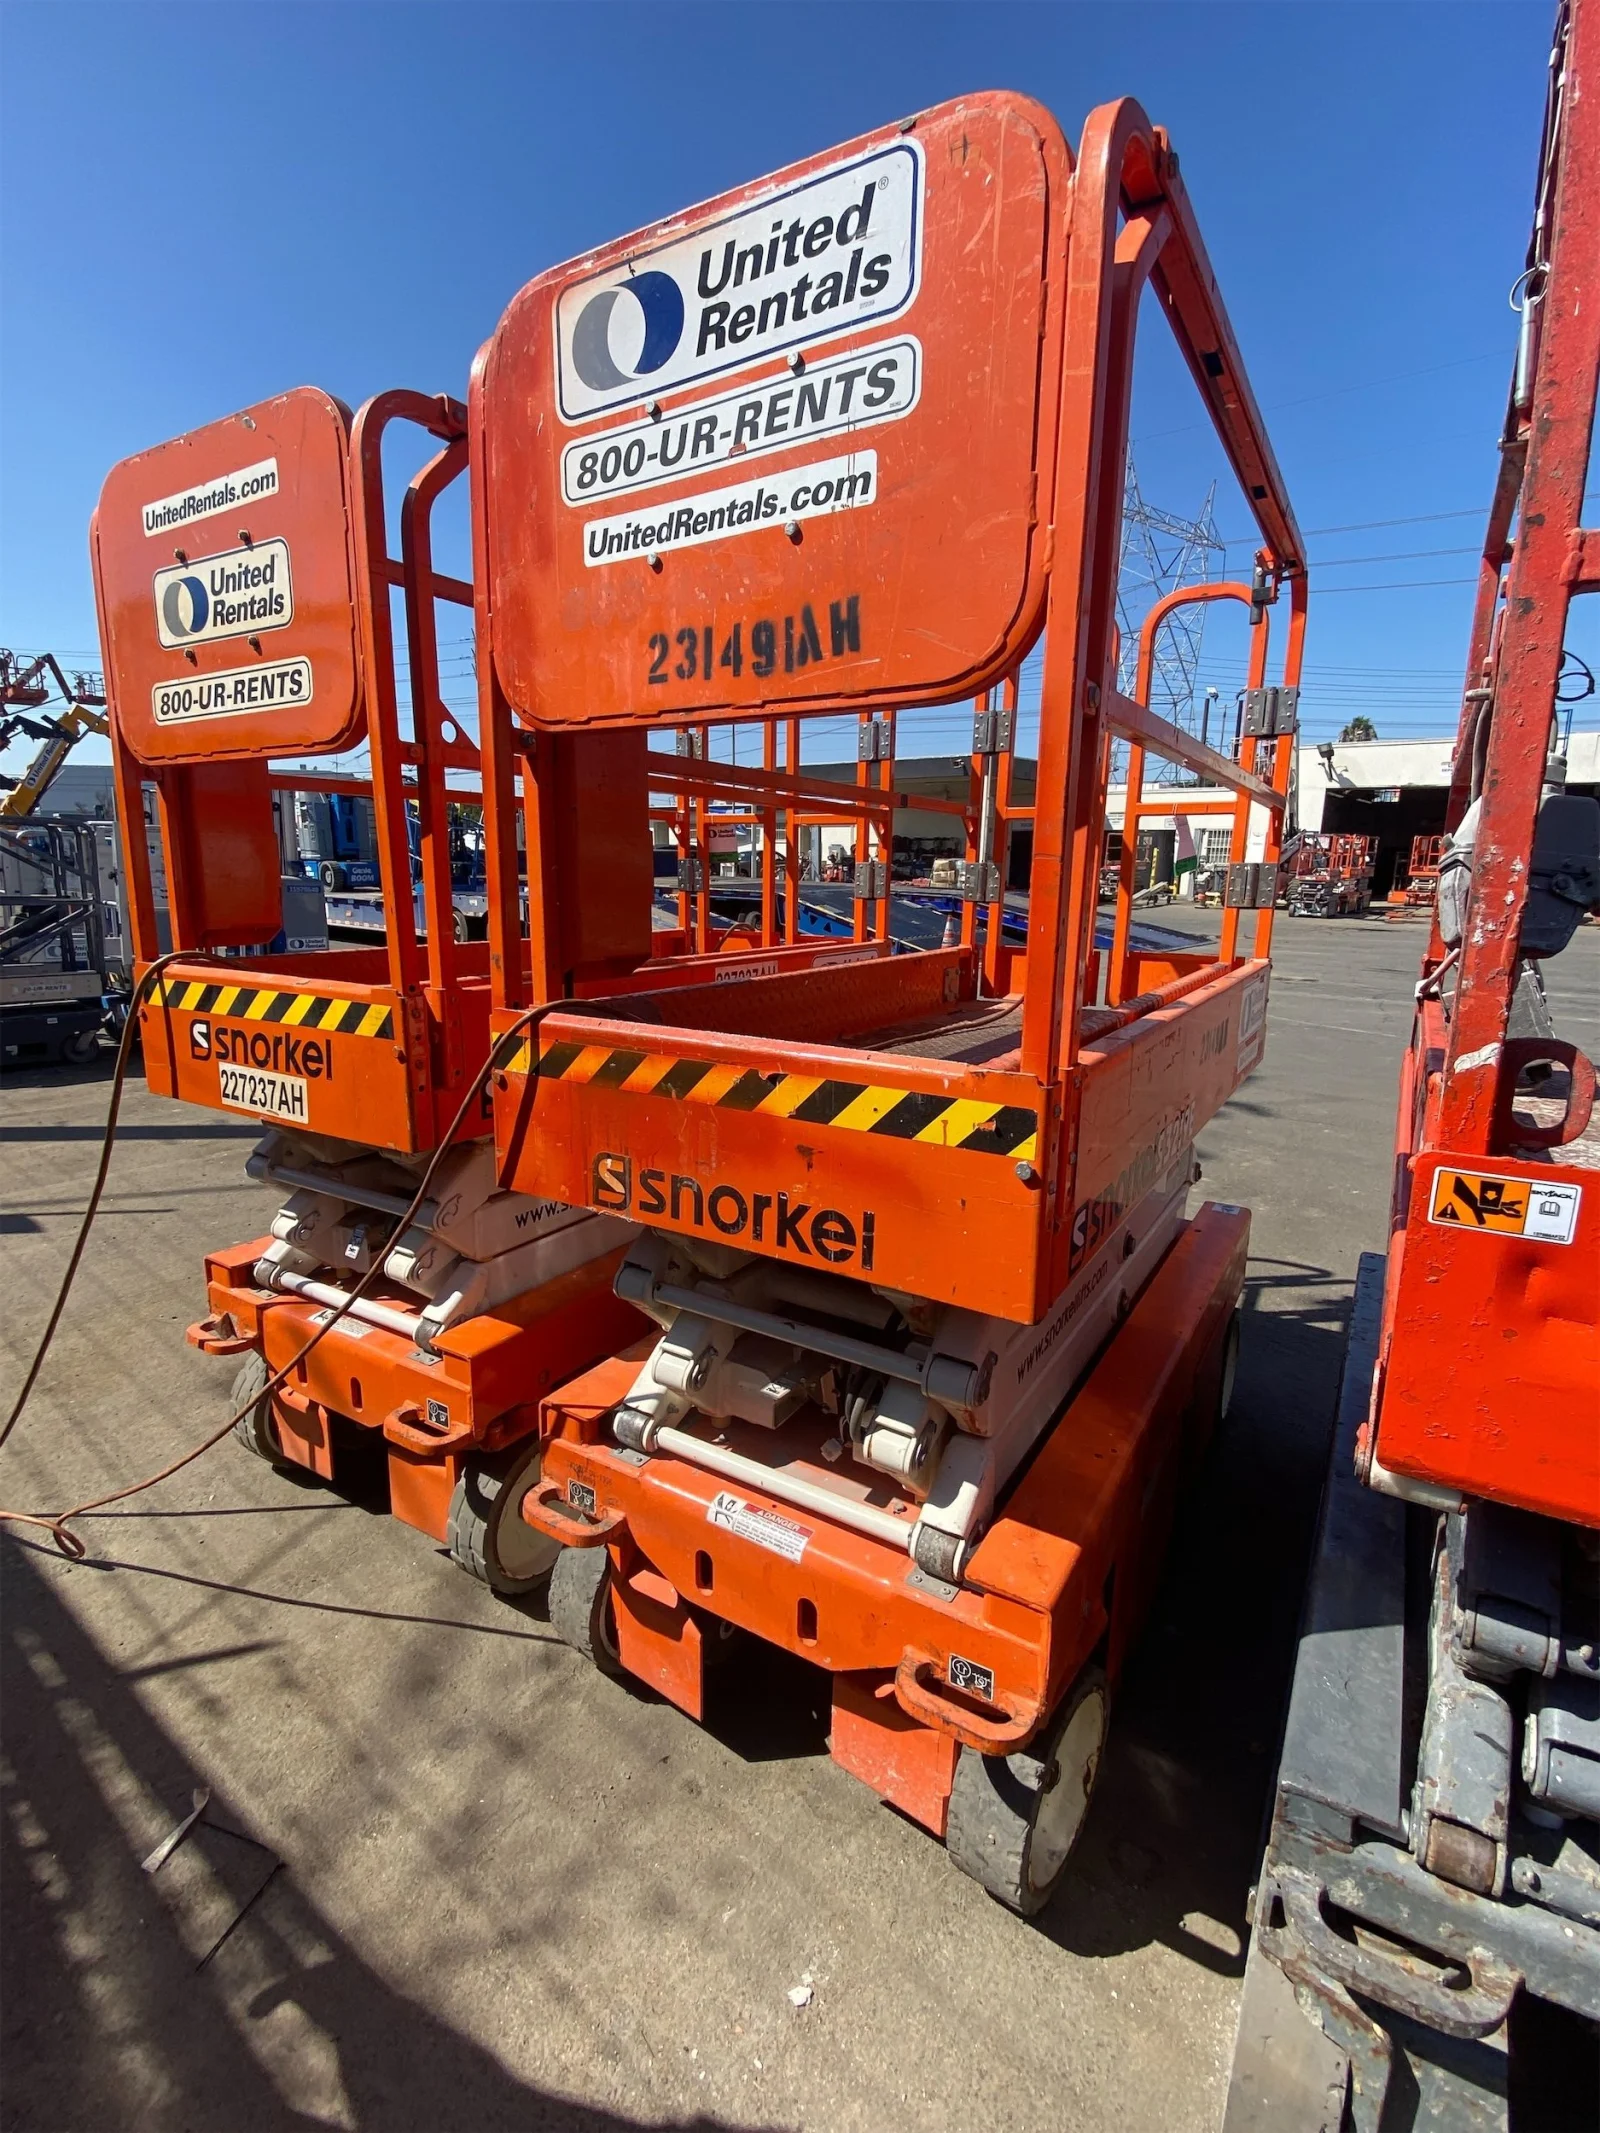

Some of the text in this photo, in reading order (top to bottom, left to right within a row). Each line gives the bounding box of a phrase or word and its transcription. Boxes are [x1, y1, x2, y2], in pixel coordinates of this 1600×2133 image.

[697, 181, 876, 299] United
[695, 249, 892, 358] Rentals
[577, 358, 898, 490] 800-UR-RENTS
[145, 471, 276, 531] UnitedRentals.com
[588, 470, 871, 558] UnitedRentals.com
[210, 554, 275, 596] United
[212, 588, 284, 627] Rentals
[160, 669, 303, 715] 800-UR-RENTS
[33, 754, 49, 778] United
[351, 874, 374, 882] BOOM
[215, 1027, 332, 1080] snorkel
[221, 1069, 304, 1117] 227237AH
[640, 1168, 876, 1271] snorkel
[764, 1511, 800, 1532] DANGER
